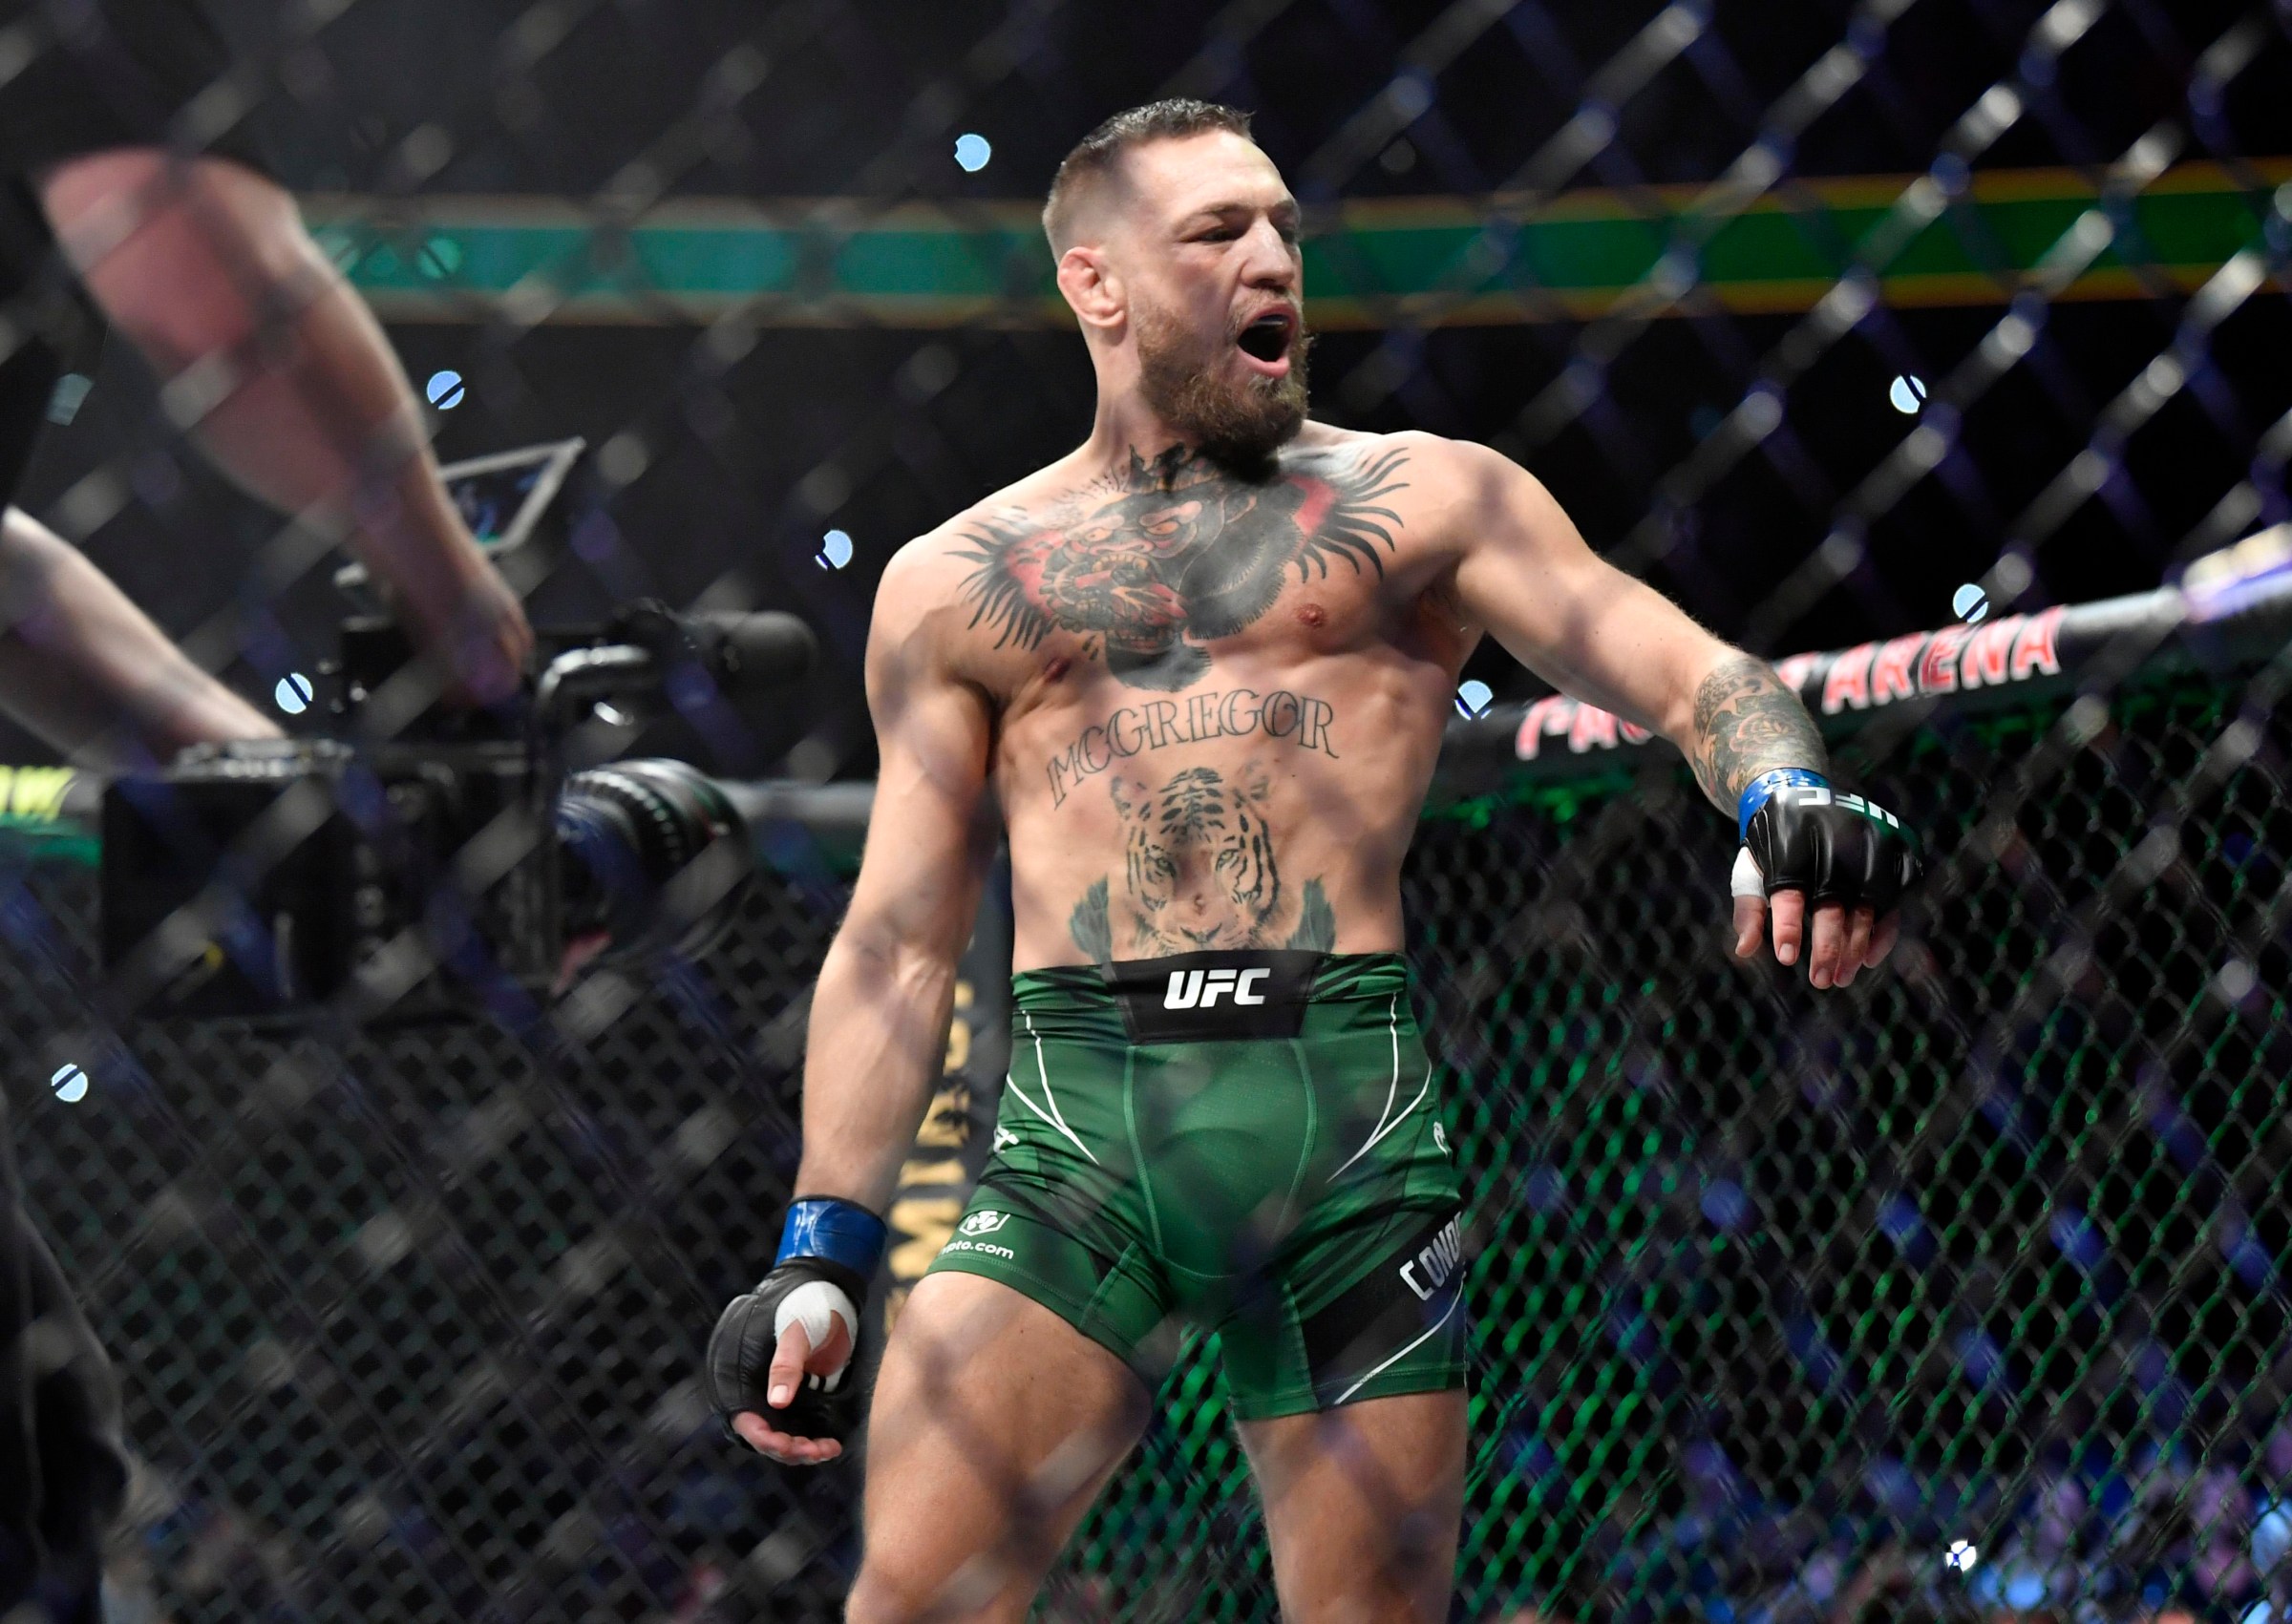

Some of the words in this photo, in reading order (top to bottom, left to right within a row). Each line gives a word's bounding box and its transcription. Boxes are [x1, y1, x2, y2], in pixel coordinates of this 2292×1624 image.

[1820, 604, 2062, 715] ARENA
[1047, 689, 1340, 811] MCGREGOR
[1163, 967, 1271, 1010] UFC
[1399, 1211, 1461, 1301] CONO
